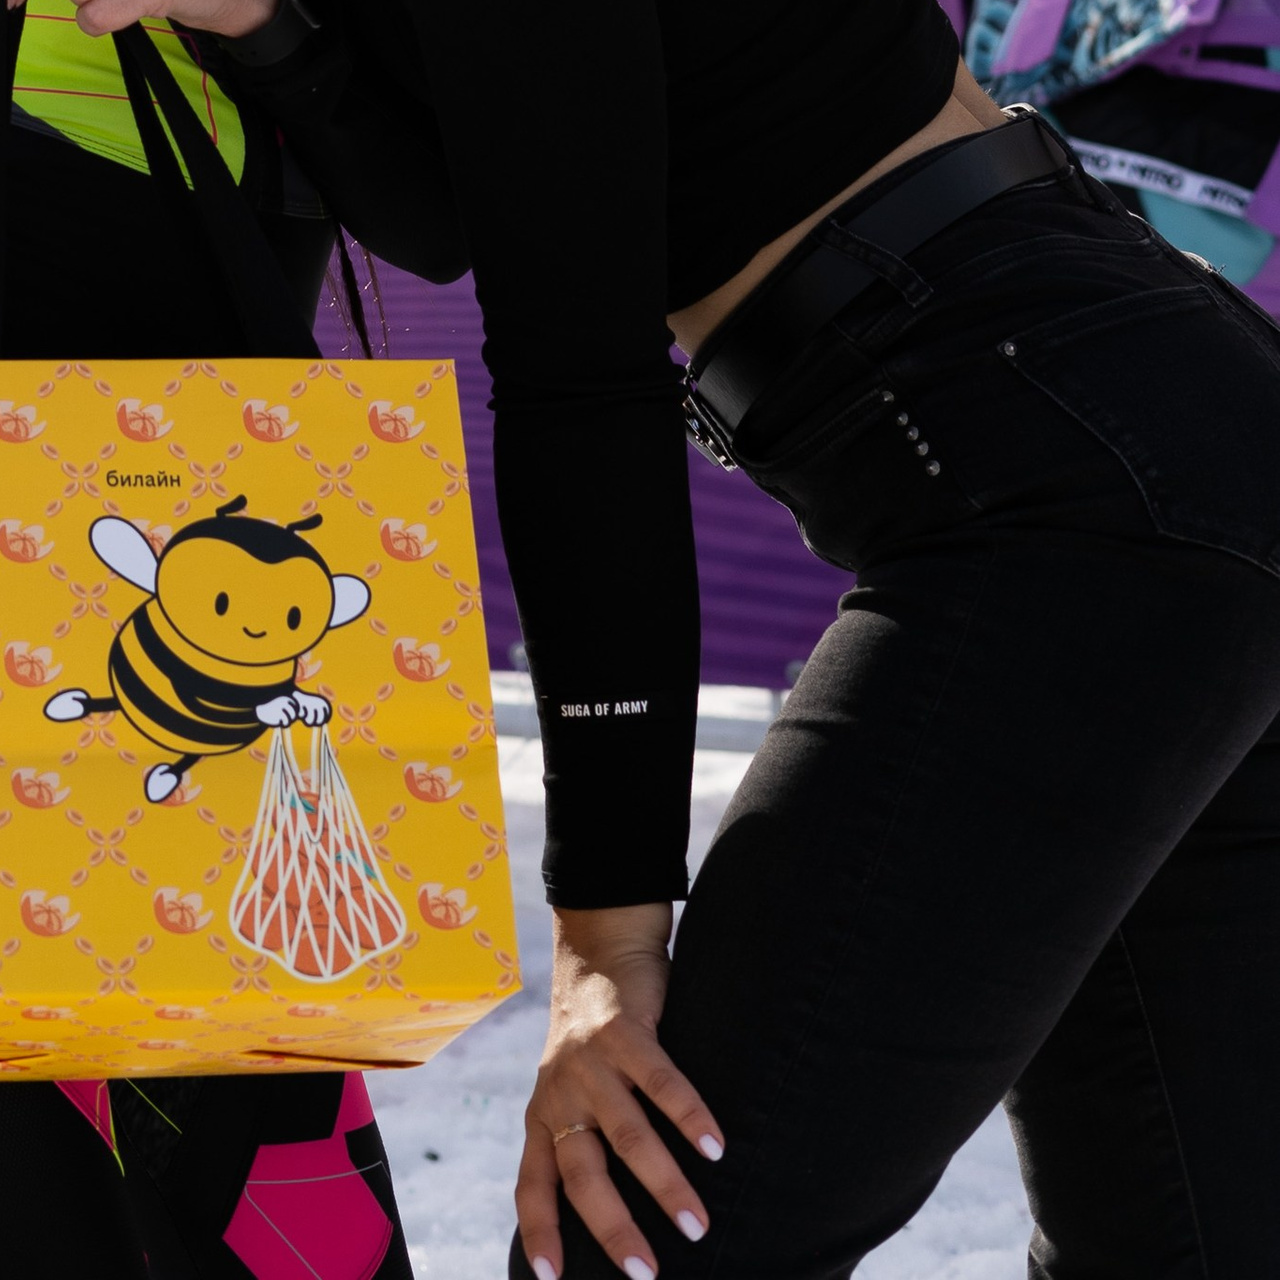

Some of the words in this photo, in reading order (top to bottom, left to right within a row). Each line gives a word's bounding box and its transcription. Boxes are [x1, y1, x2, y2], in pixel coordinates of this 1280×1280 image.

[105, 469, 181, 488] билайн
[560, 703, 591, 718] SUGA
[594, 702, 610, 717] OF
[614, 700, 648, 716] ARMY
